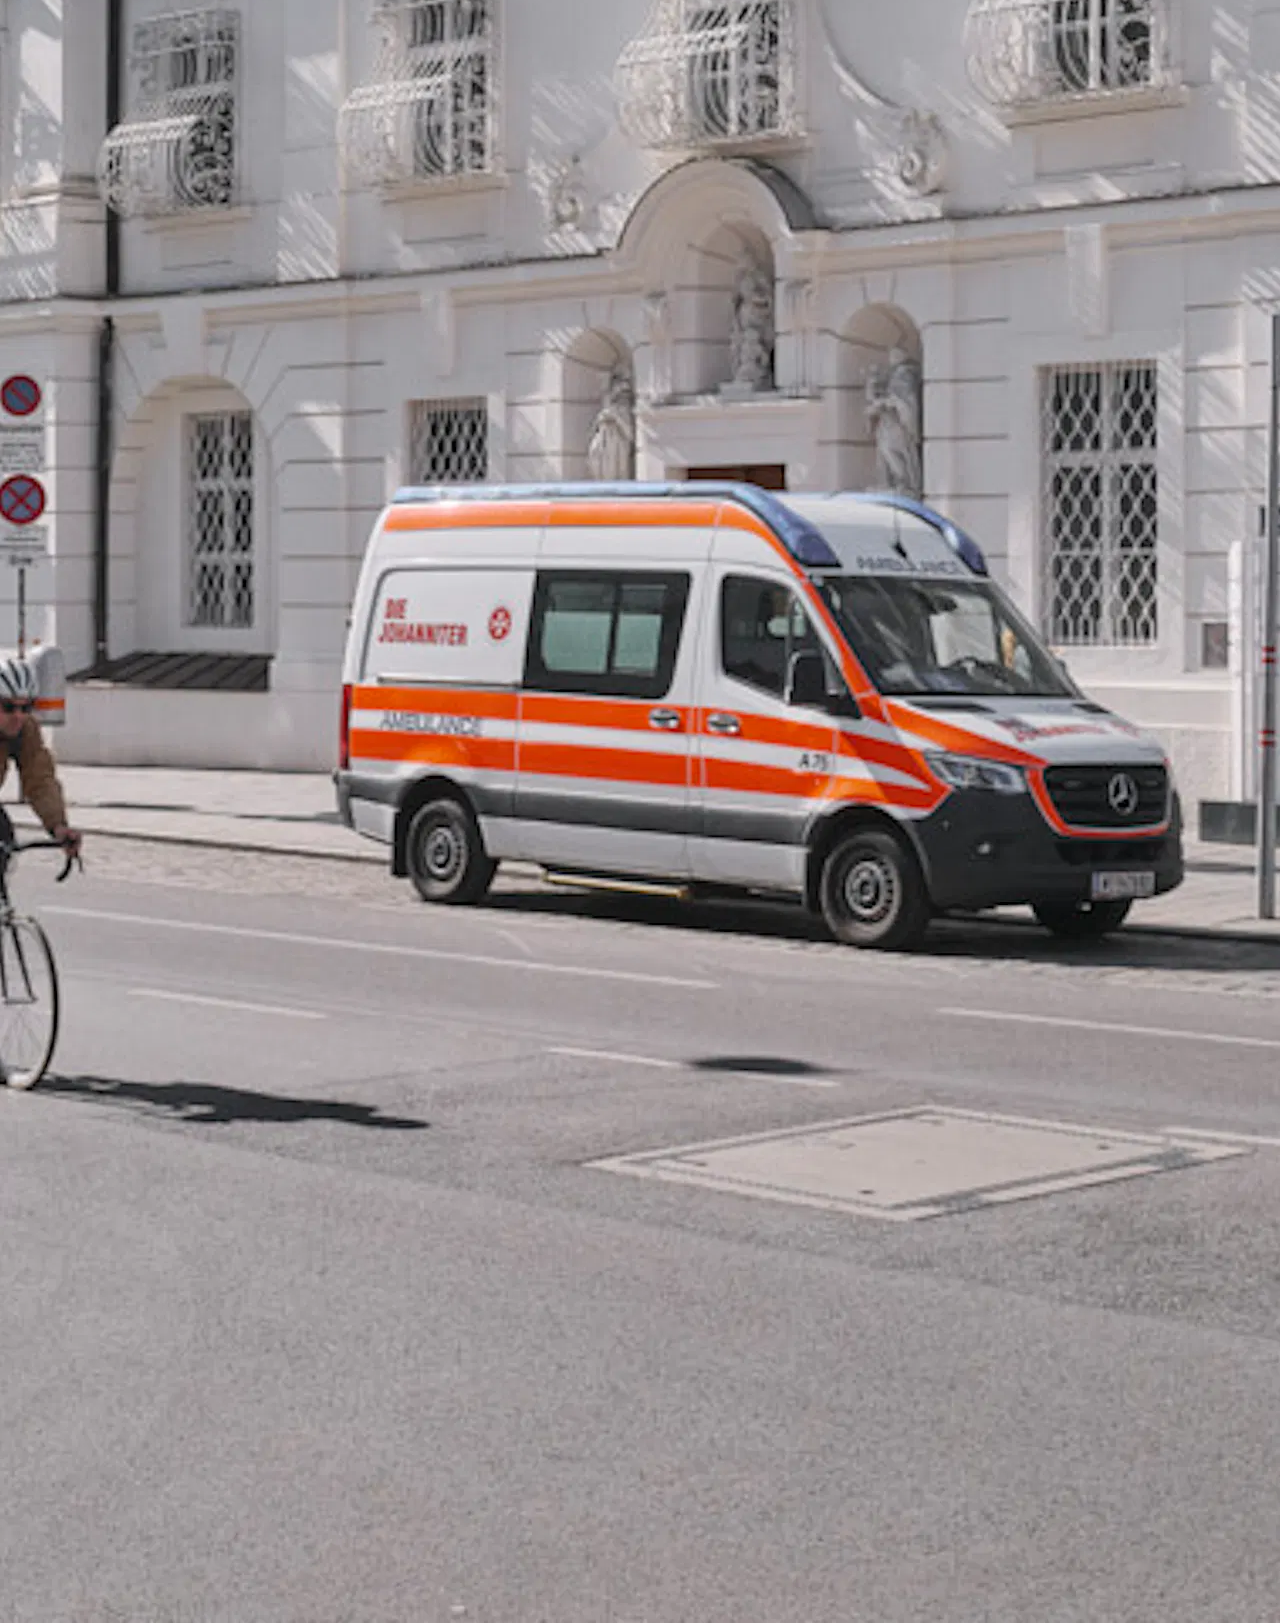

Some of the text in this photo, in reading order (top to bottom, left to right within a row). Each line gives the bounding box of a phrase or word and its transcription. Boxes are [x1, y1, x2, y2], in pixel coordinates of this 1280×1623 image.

[384, 597, 408, 620] DIE
[378, 621, 469, 647] JOHANNITER
[380, 709, 483, 738] AMBULANCE
